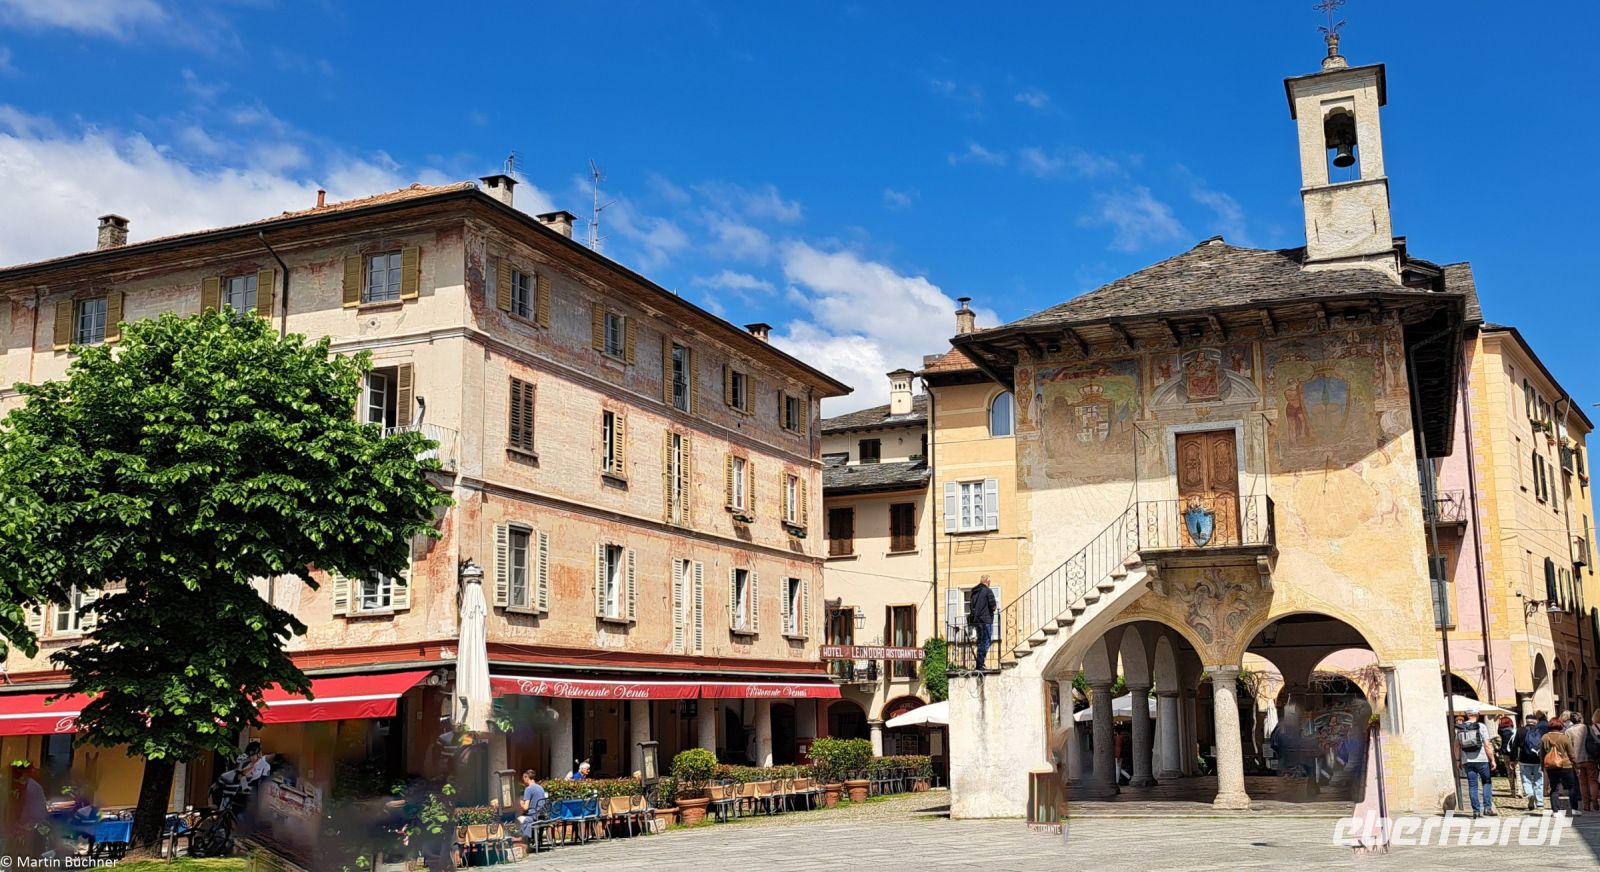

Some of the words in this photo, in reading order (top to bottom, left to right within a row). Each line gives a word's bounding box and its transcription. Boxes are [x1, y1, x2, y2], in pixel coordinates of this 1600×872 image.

[823, 646, 843, 658] HOTEL
[851, 647, 868, 659] LEON
[885, 648, 918, 659] RISTORANTE
[553, 681, 610, 698] Ristorante
[613, 684, 650, 698] Venus
[782, 685, 807, 697] Venus
